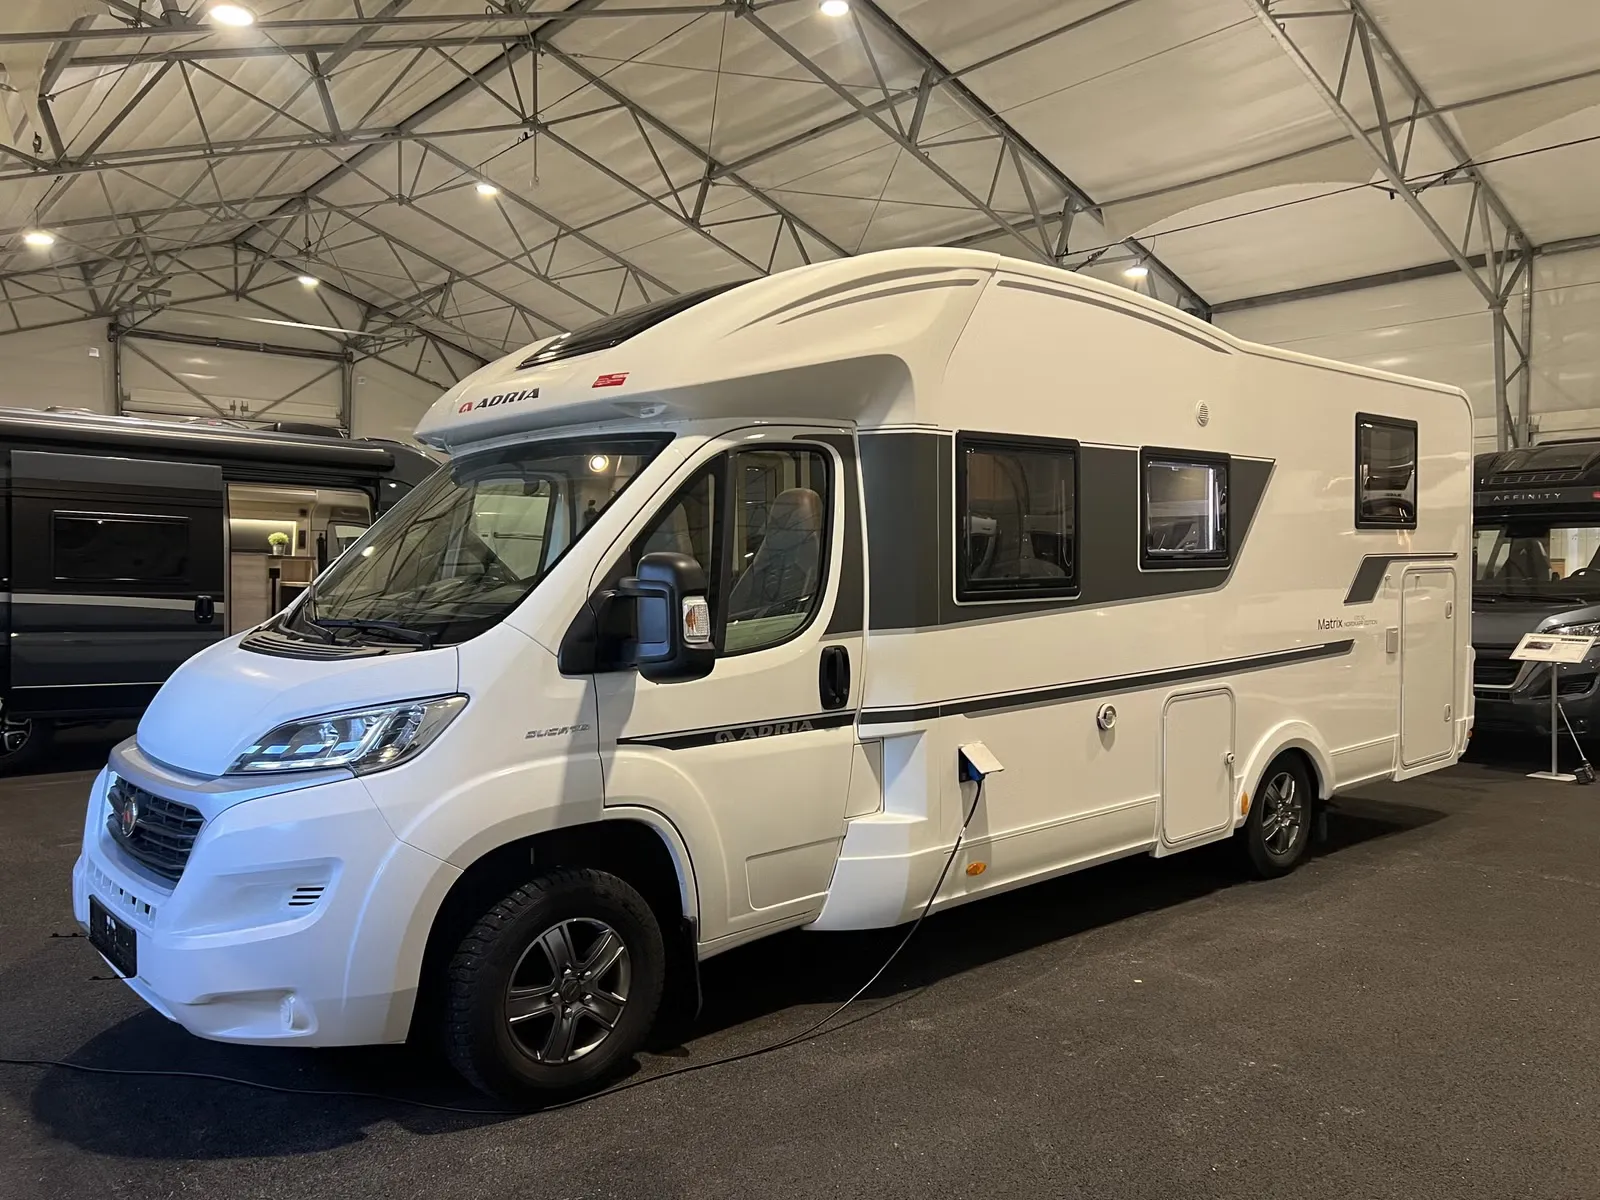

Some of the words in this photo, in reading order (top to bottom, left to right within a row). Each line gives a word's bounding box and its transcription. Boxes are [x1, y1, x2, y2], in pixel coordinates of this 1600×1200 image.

[474, 387, 540, 410] ADRIA
[1493, 492, 1561, 501] AFFINITY
[1317, 617, 1343, 630] Matrix
[740, 720, 814, 740] ADRIA
